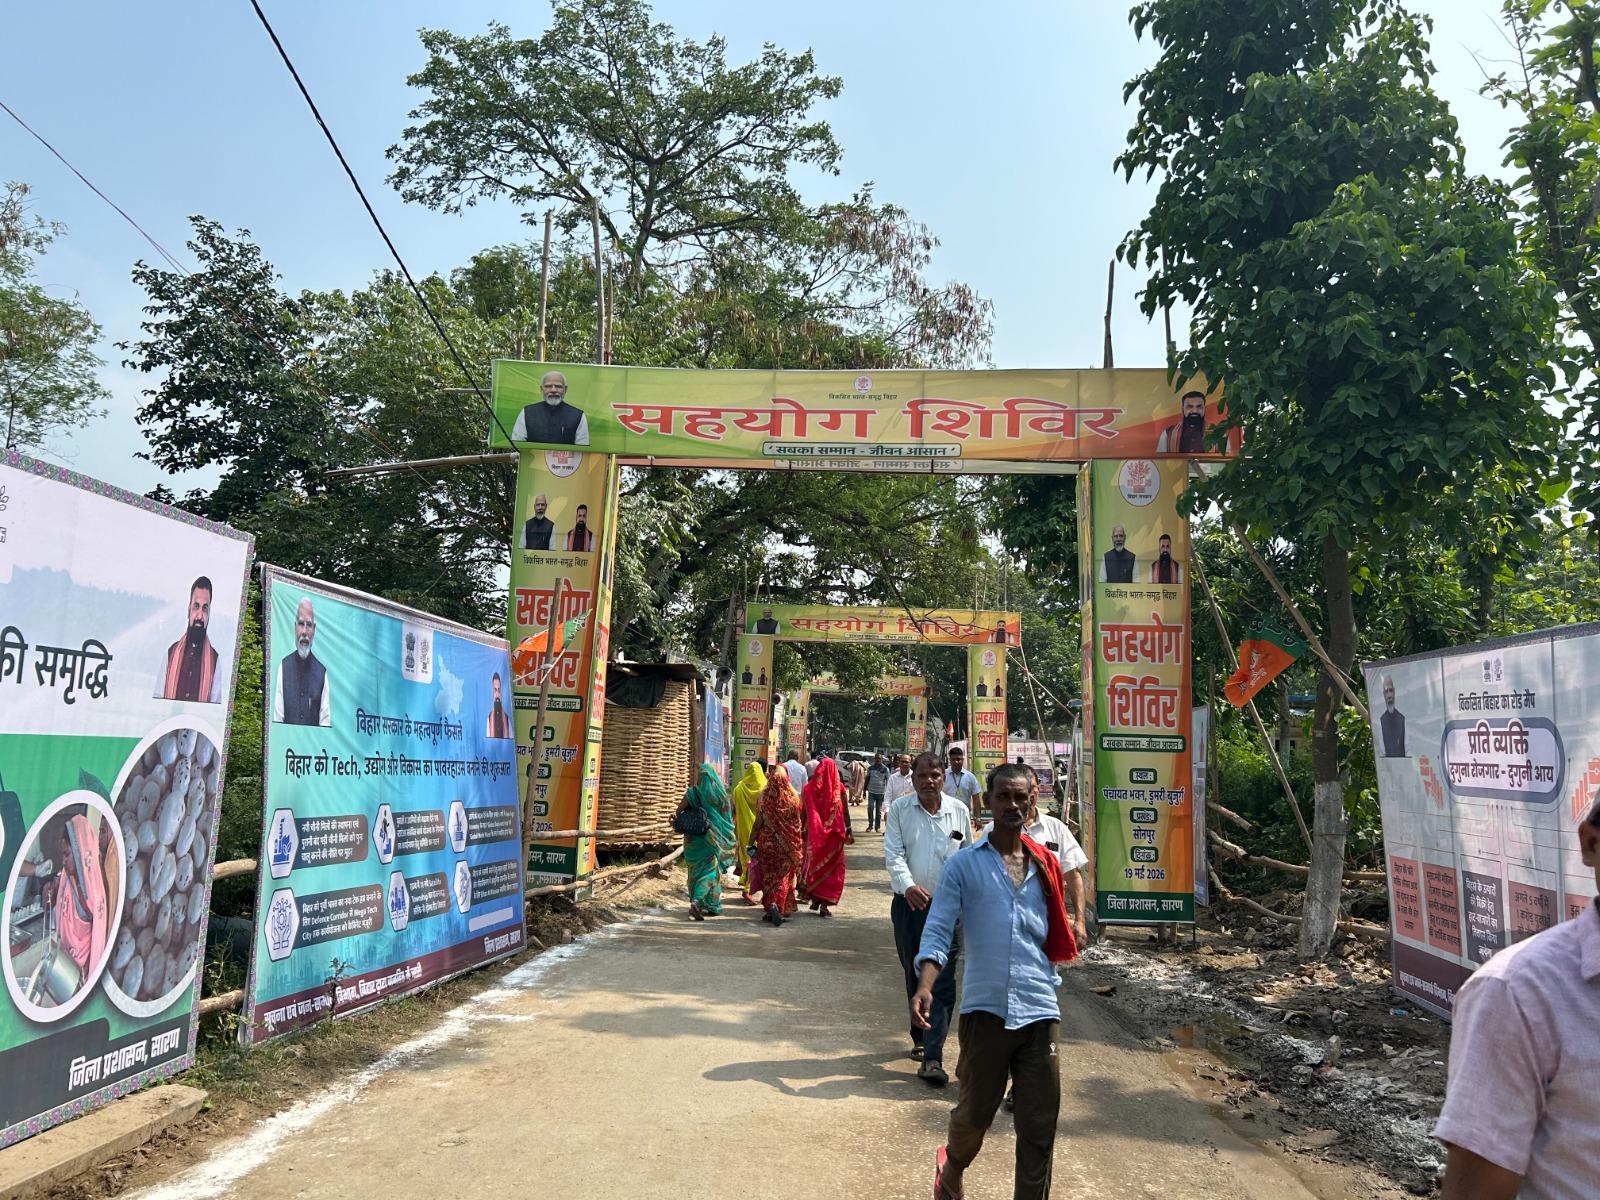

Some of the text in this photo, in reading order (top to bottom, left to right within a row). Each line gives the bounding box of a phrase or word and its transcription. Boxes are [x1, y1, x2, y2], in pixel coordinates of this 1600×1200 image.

[611, 397, 1123, 442] सहयोग शिविर
[776, 445, 946, 456] सबका सम्मान जीवन आसान
[790, 616, 887, 632] सहयोग
[1100, 611, 1184, 665] सहयोग
[34, 638, 112, 705] समृद्धि
[1106, 674, 1179, 728] शिविर
[1458, 688, 1535, 711] विकसित बिहार का रोड मैप
[356, 708, 380, 736] बिहार
[382, 716, 403, 736] सरकार
[405, 713, 412, 736] के
[444, 715, 463, 741] फैसले
[975, 708, 1005, 725] सहयोग
[977, 731, 1003, 749] शिविर
[1468, 721, 1529, 754] प्रति व्यक्ति
[285, 748, 312, 779] बिहार
[314, 749, 328, 776] को
[332, 754, 360, 780] Tech,
[364, 751, 386, 775] उद्योग
[387, 751, 398, 776] और
[399, 754, 421, 776] विकास
[423, 760, 432, 776] का
[434, 760, 465, 779] पावरहाउस
[466, 756, 480, 776] बनाने
[481, 756, 489, 776] की
[1449, 758, 1554, 787] दुगुना रोजगार दुगुनी आय
[1103, 787, 1184, 806] पंचायत भवन, डुमरी बुजुर्ग
[536, 822, 552, 832] 2026
[1133, 826, 1155, 844] सोनपुर
[546, 852, 566, 864] सारण
[1125, 865, 1165, 880] 19 मई 2026
[1107, 894, 1184, 912] जिला प्रशासन, सारण
[264, 1007, 285, 1032] सूचना
[286, 1000, 298, 1020] एवं
[68, 1028, 181, 1091] जिला प्रशासन, सारण
